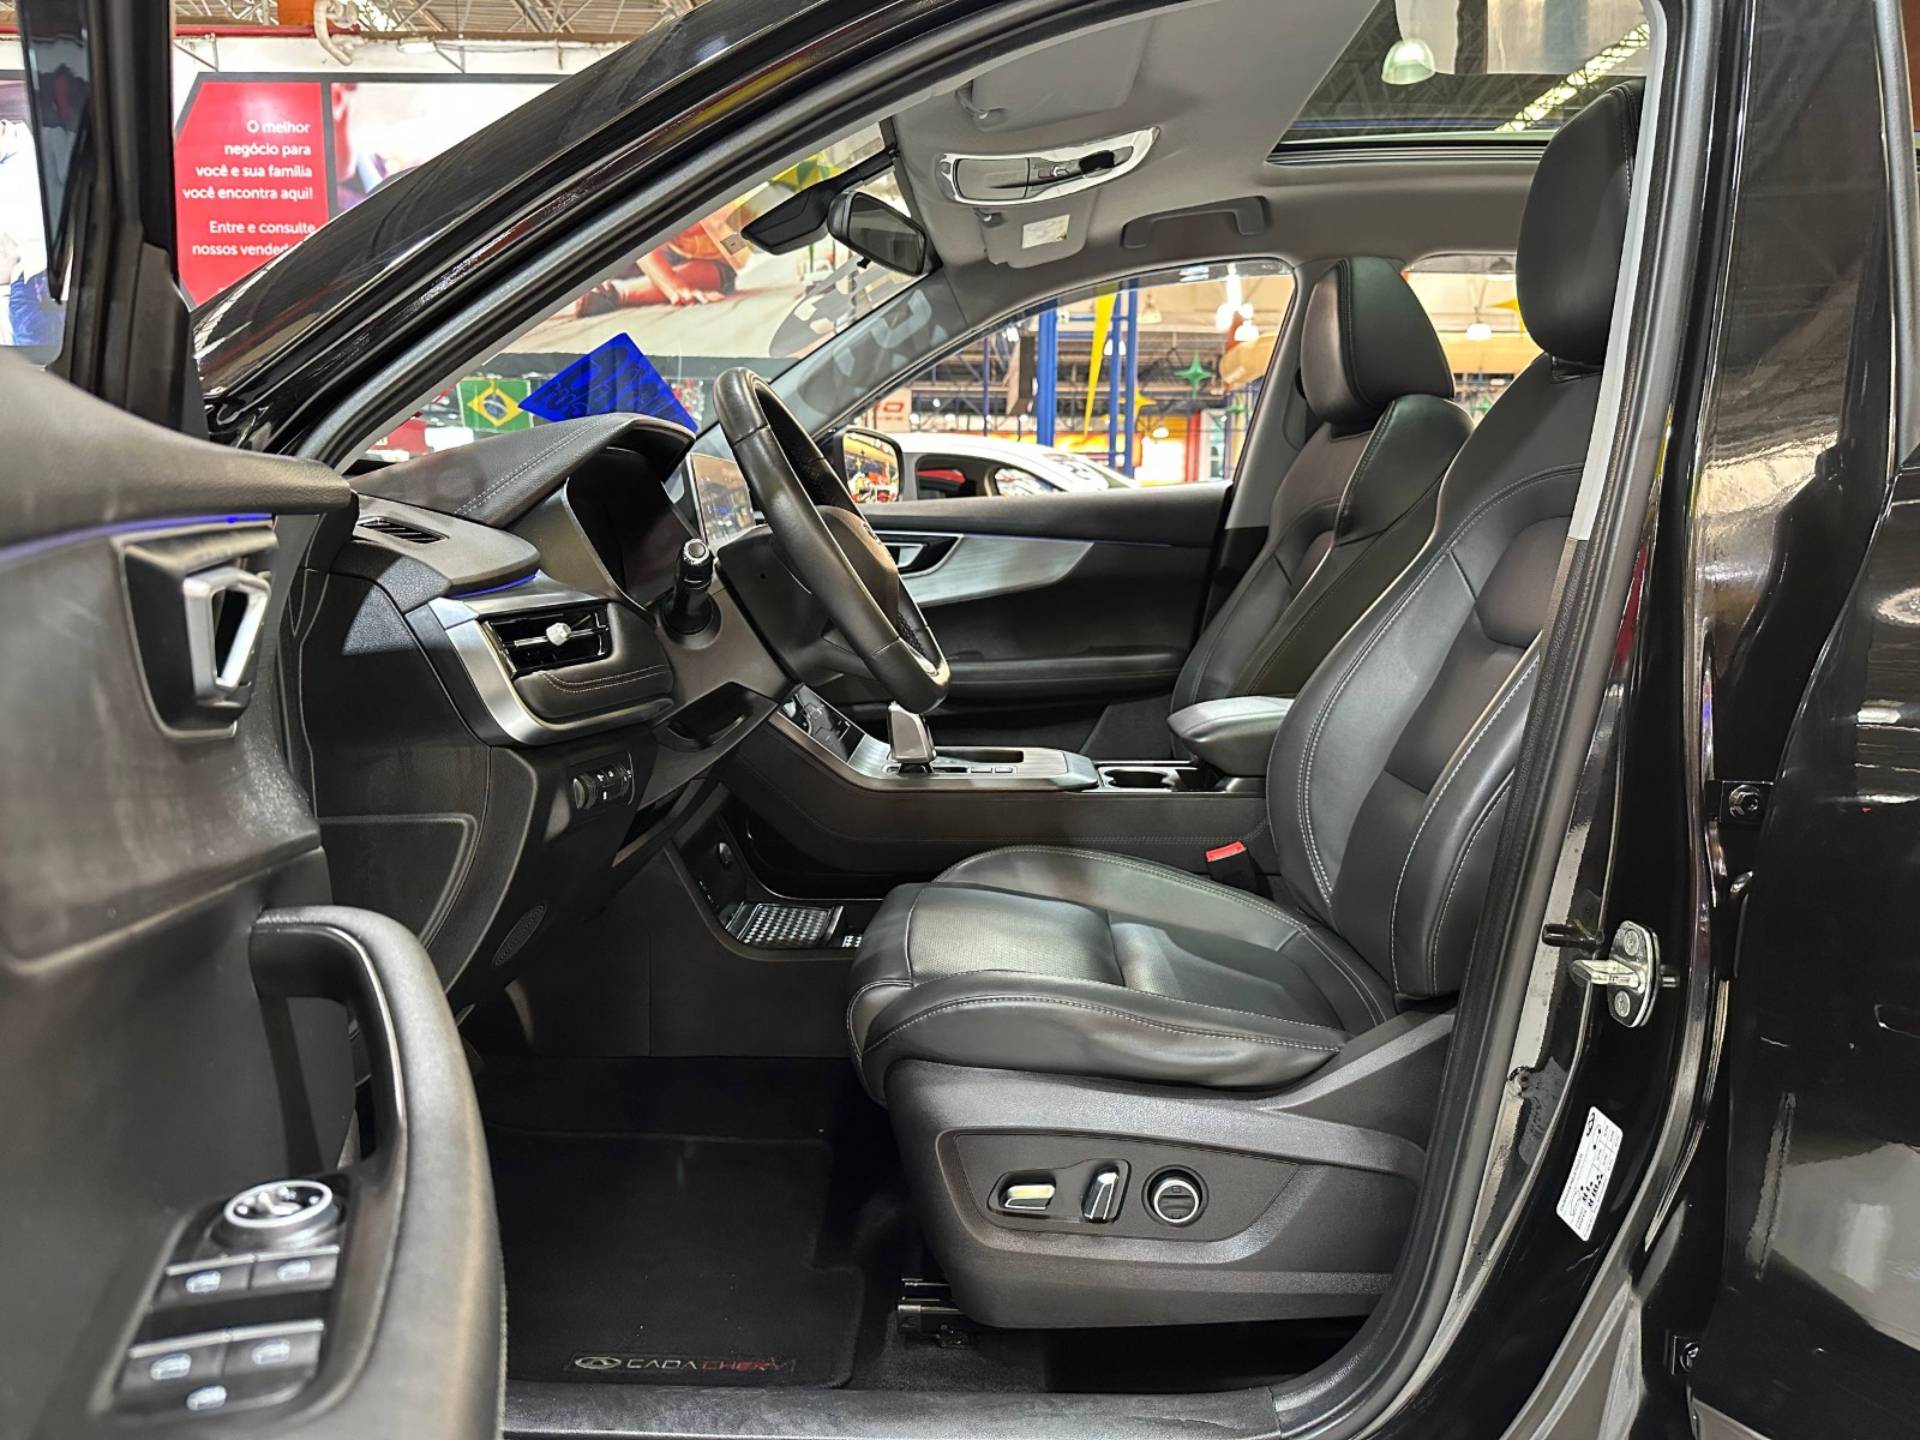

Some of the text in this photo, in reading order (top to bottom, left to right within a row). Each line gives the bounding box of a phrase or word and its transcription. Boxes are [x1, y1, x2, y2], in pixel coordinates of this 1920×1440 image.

[246, 120, 311, 133] O melhor
[224, 143, 312, 158] negócio para
[195, 164, 229, 177] você
[230, 167, 240, 177] e
[242, 167, 266, 177] sua
[182, 185, 313, 202] você encontra aqui!
[209, 220, 317, 234] Entre e consulte
[192, 244, 238, 256] nossos
